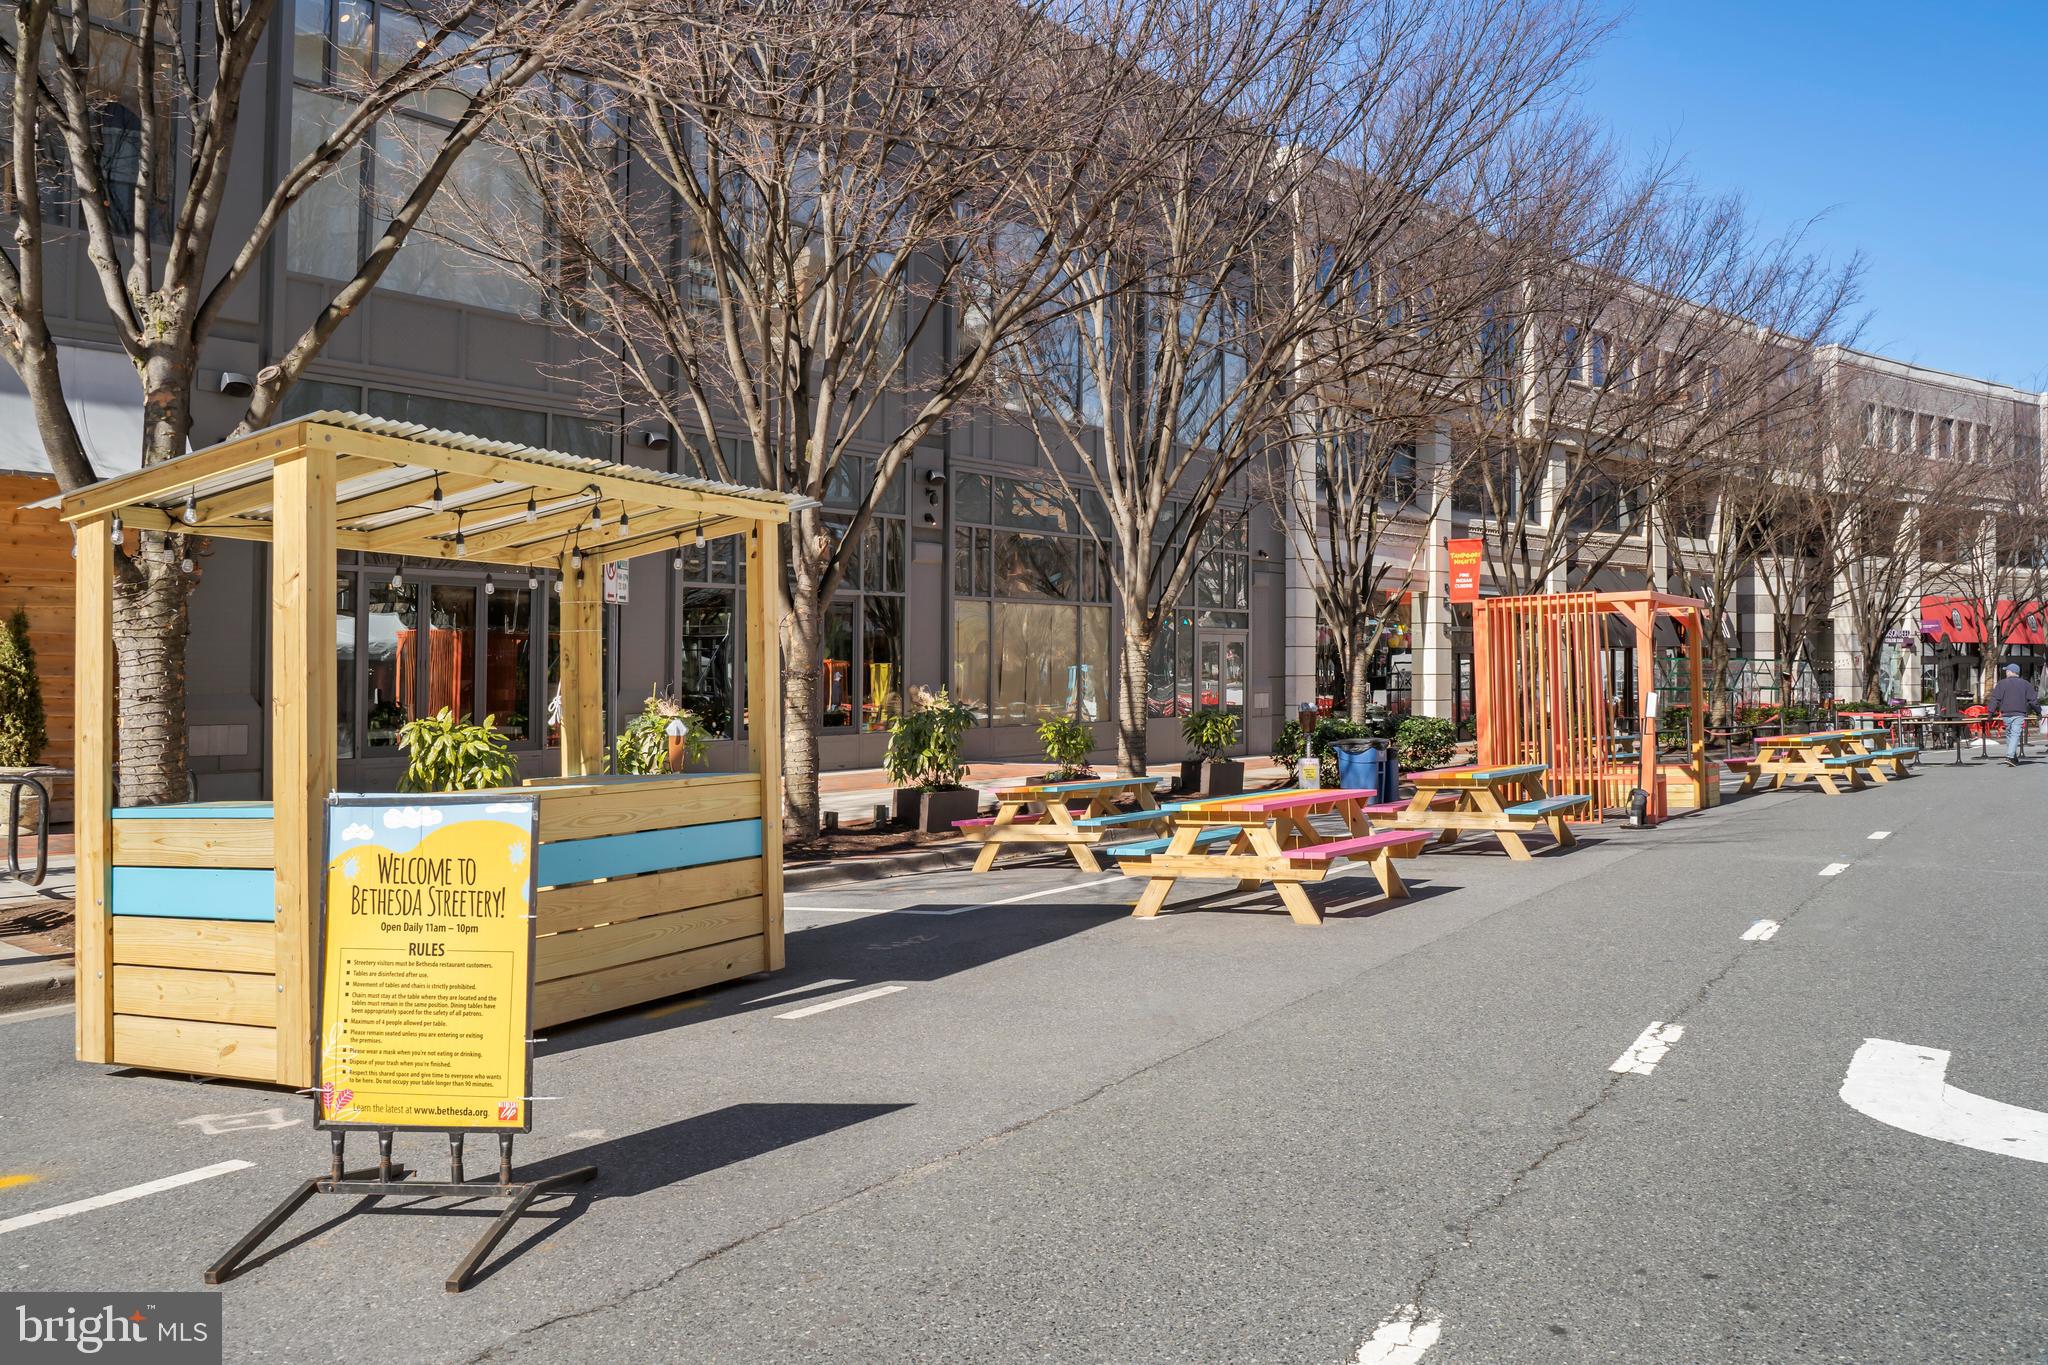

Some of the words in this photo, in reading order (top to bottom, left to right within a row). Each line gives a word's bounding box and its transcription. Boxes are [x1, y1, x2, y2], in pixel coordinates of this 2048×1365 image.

[378, 853, 452, 886] WELCOME
[458, 858, 476, 885] TO
[351, 885, 422, 916] BETHESDA
[428, 886, 506, 918] STREETERY!
[381, 922, 401, 932] Open
[404, 922, 423, 934] Daily
[426, 923, 446, 932] 11am
[456, 923, 478, 934] 10pm
[409, 943, 445, 957] RULES
[364, 1007, 397, 1016] appropriately
[353, 1104, 372, 1113] Learn
[372, 1104, 384, 1113] the
[386, 1104, 404, 1113] latest
[414, 1106, 488, 1118] www.bethesda.org
